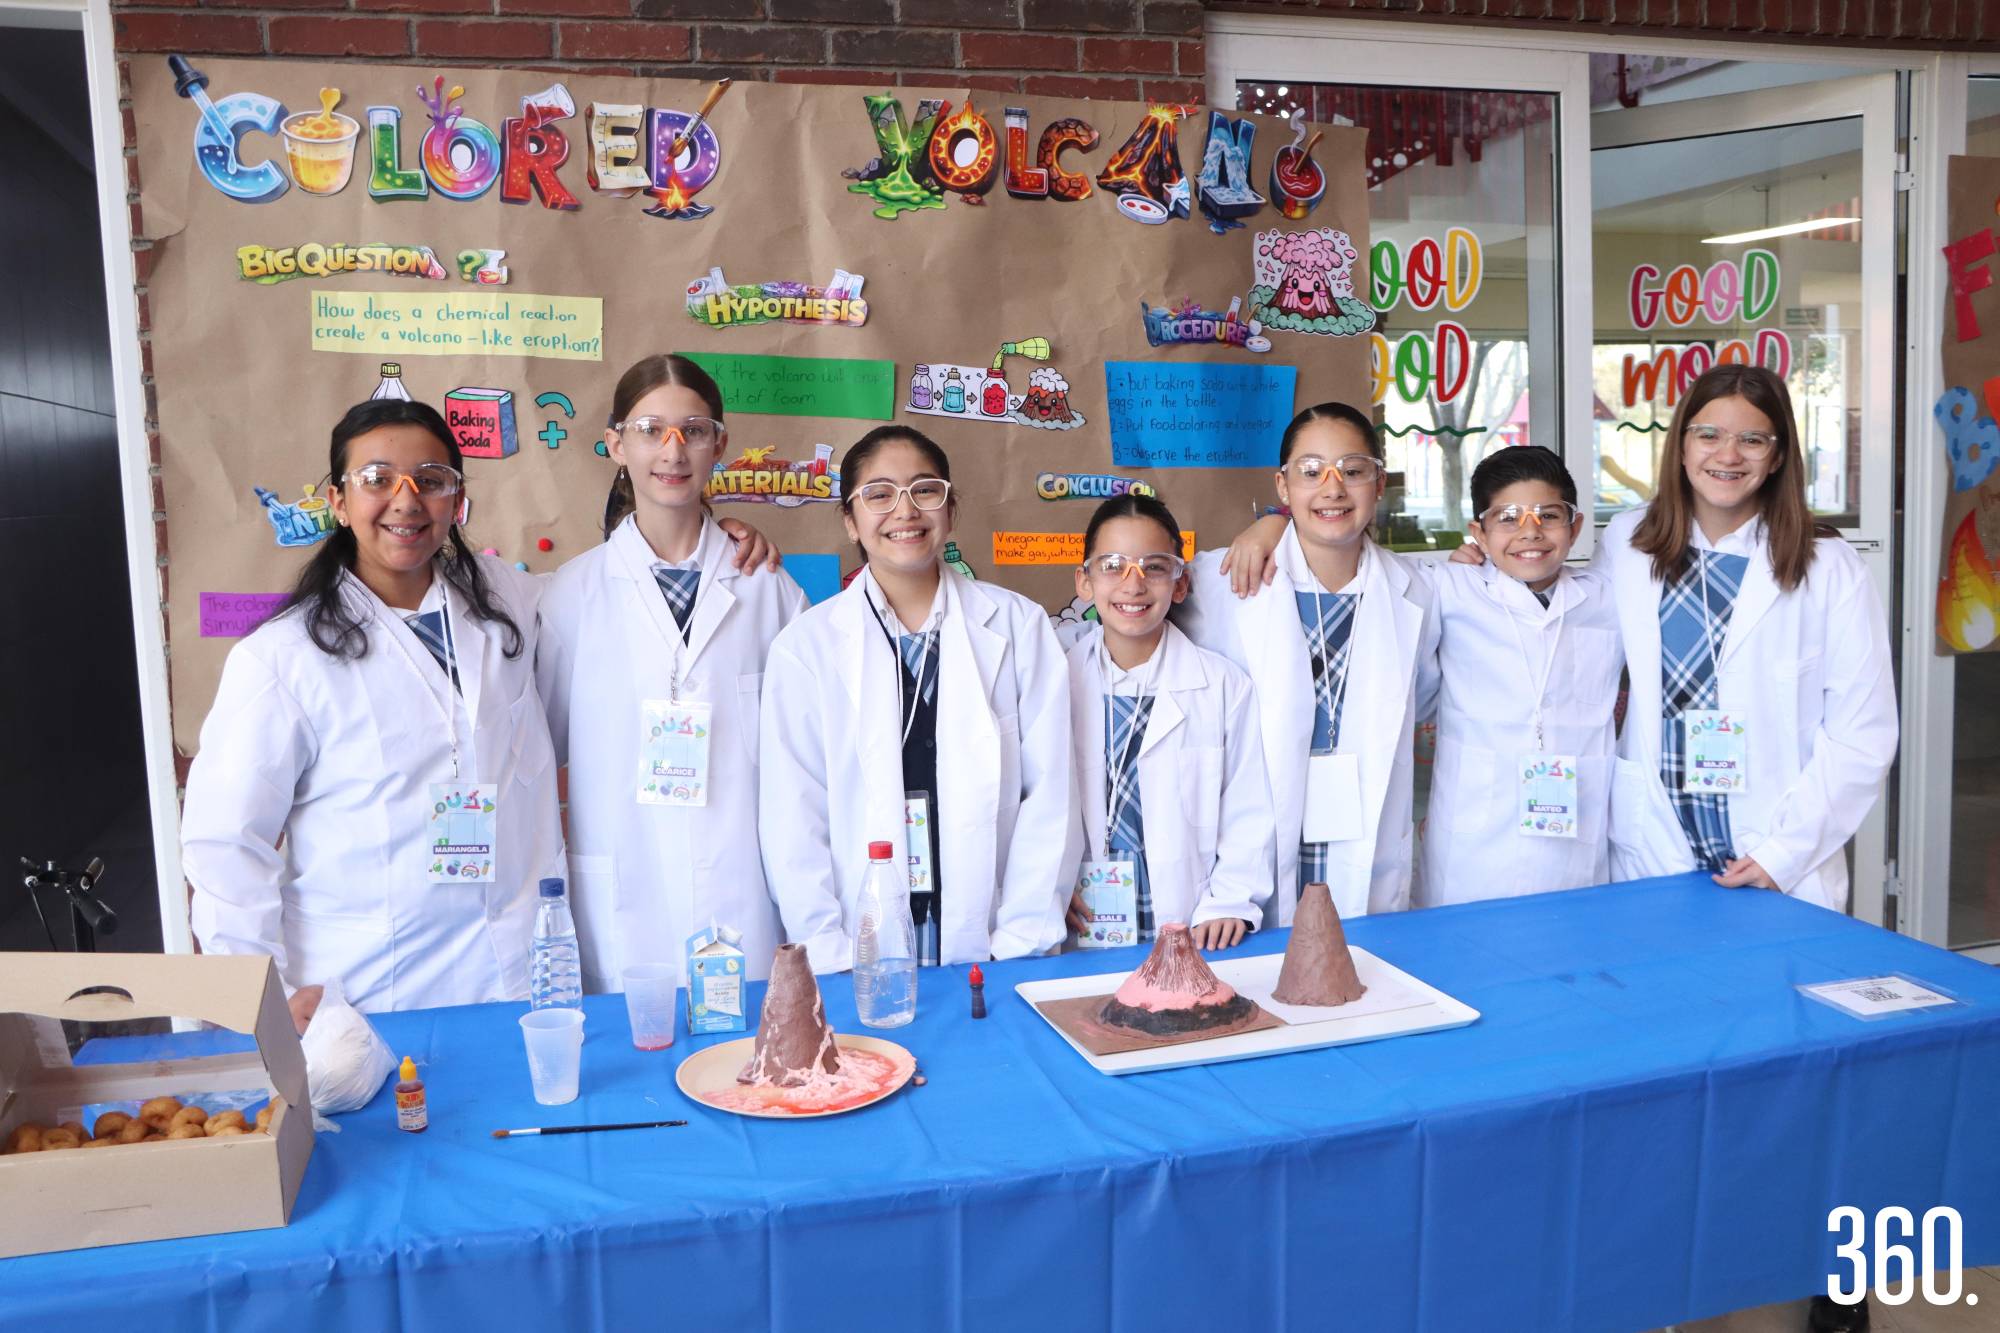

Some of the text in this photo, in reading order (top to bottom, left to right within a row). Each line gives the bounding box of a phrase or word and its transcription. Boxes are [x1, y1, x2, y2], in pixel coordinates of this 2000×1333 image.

[1371, 228, 1482, 310] OOD
[1631, 250, 1780, 329] GOOD
[316, 295, 577, 323] How does a chemical reaction
[705, 292, 867, 325] HYPOTHESIS
[314, 324, 366, 342] create
[380, 331, 390, 341] a
[523, 333, 600, 358] eruption?
[1146, 317, 1250, 346] PROCEDURE
[1154, 371, 1196, 392] baking
[449, 409, 495, 433] Baking
[458, 431, 491, 449] Soda
[995, 531, 1041, 550] Vinegar
[1046, 532, 1065, 544] and
[995, 547, 1025, 558] make
[203, 596, 231, 613] The
[434, 846, 488, 854] MARIANGELA
